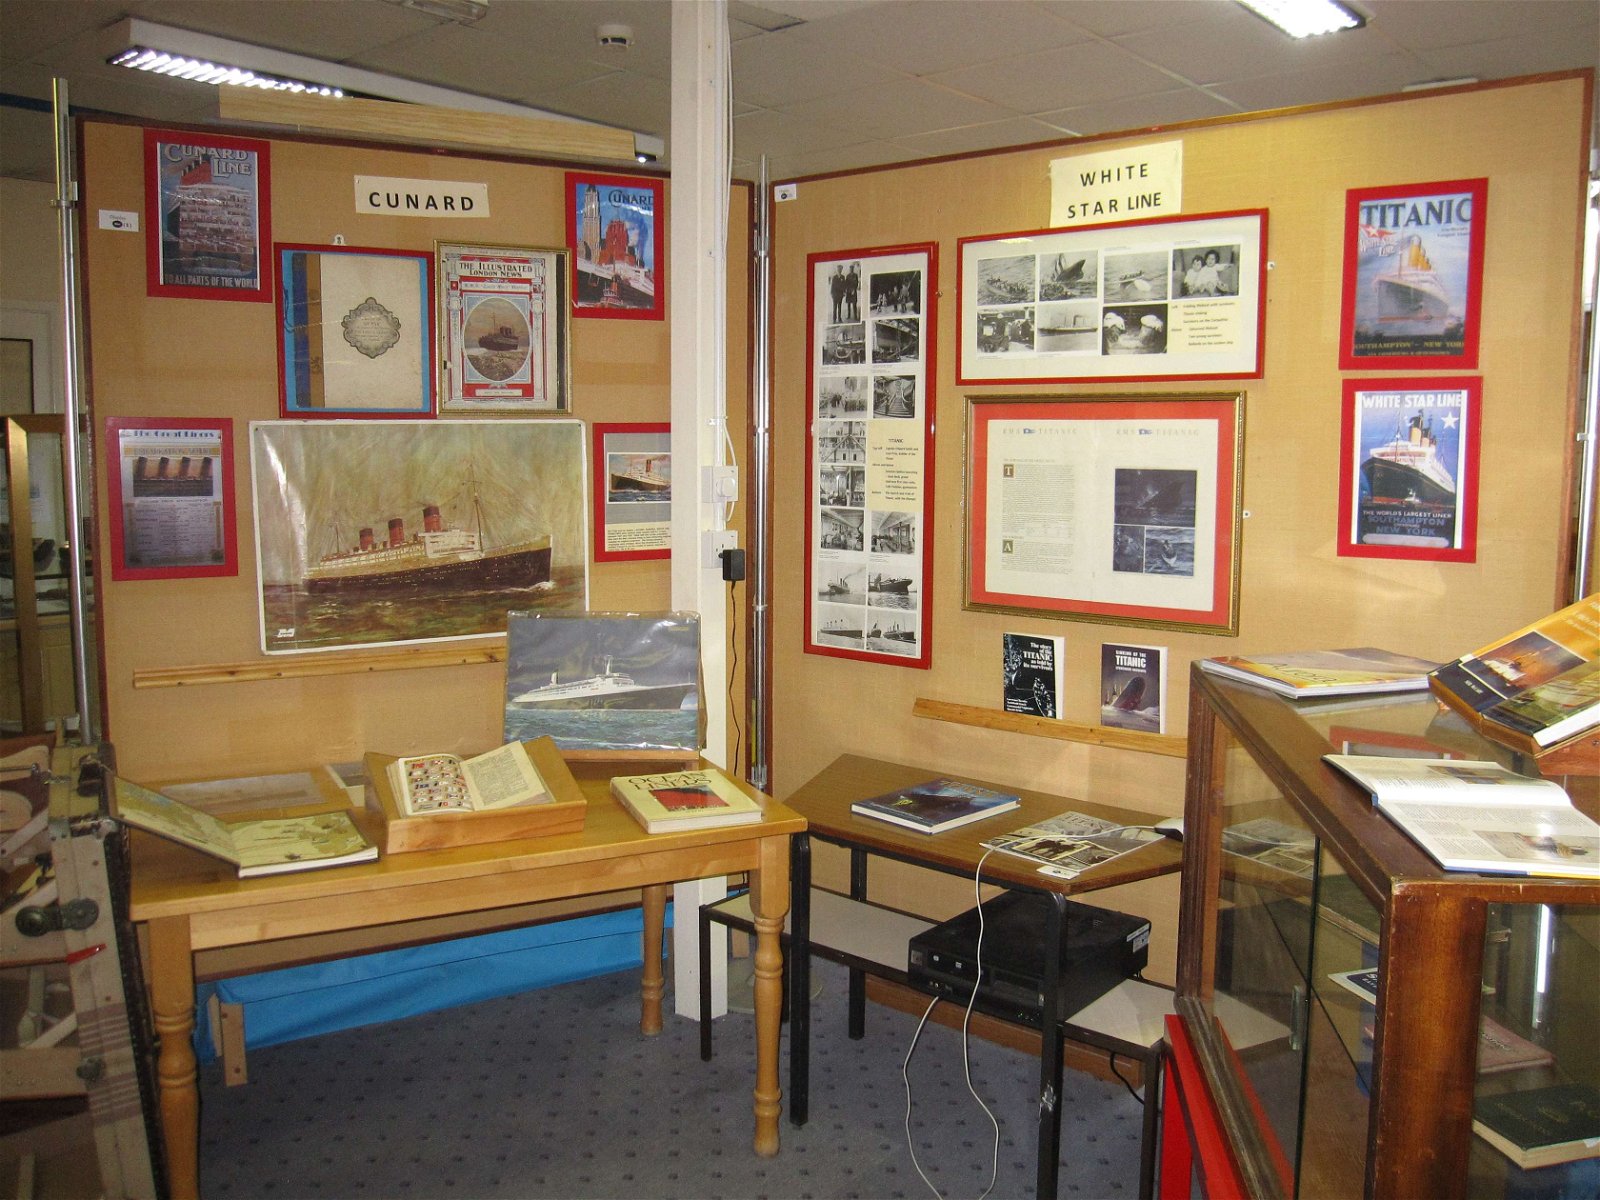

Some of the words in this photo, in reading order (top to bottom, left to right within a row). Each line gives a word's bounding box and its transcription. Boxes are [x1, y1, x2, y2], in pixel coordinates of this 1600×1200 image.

[164, 143, 248, 162] CUNARD
[213, 158, 251, 177] LINE
[1080, 163, 1149, 187] WHITE
[368, 191, 474, 211] CUNARD
[1067, 199, 1118, 219] STAR
[1128, 192, 1161, 210] LINE
[1360, 198, 1472, 228] TITANIC
[469, 269, 498, 277] LONDON
[479, 262, 533, 272] ILLUSTRATED
[175, 274, 188, 285] ALL
[188, 275, 210, 286] PARTS
[221, 276, 234, 287] THE
[234, 277, 258, 288] WORLD
[1355, 341, 1411, 350] OUTHAMPTON
[1363, 395, 1400, 409] WHITE
[1405, 394, 1435, 409] STAR
[1437, 394, 1462, 408] LINE
[1368, 515, 1445, 526] SOUTHAMPTON
[1376, 525, 1399, 534] NEW
[1407, 526, 1436, 536] YORK
[1023, 651, 1053, 661] TITANIC
[1115, 655, 1147, 668] TITANIC
[628, 771, 708, 785] OCEAN
